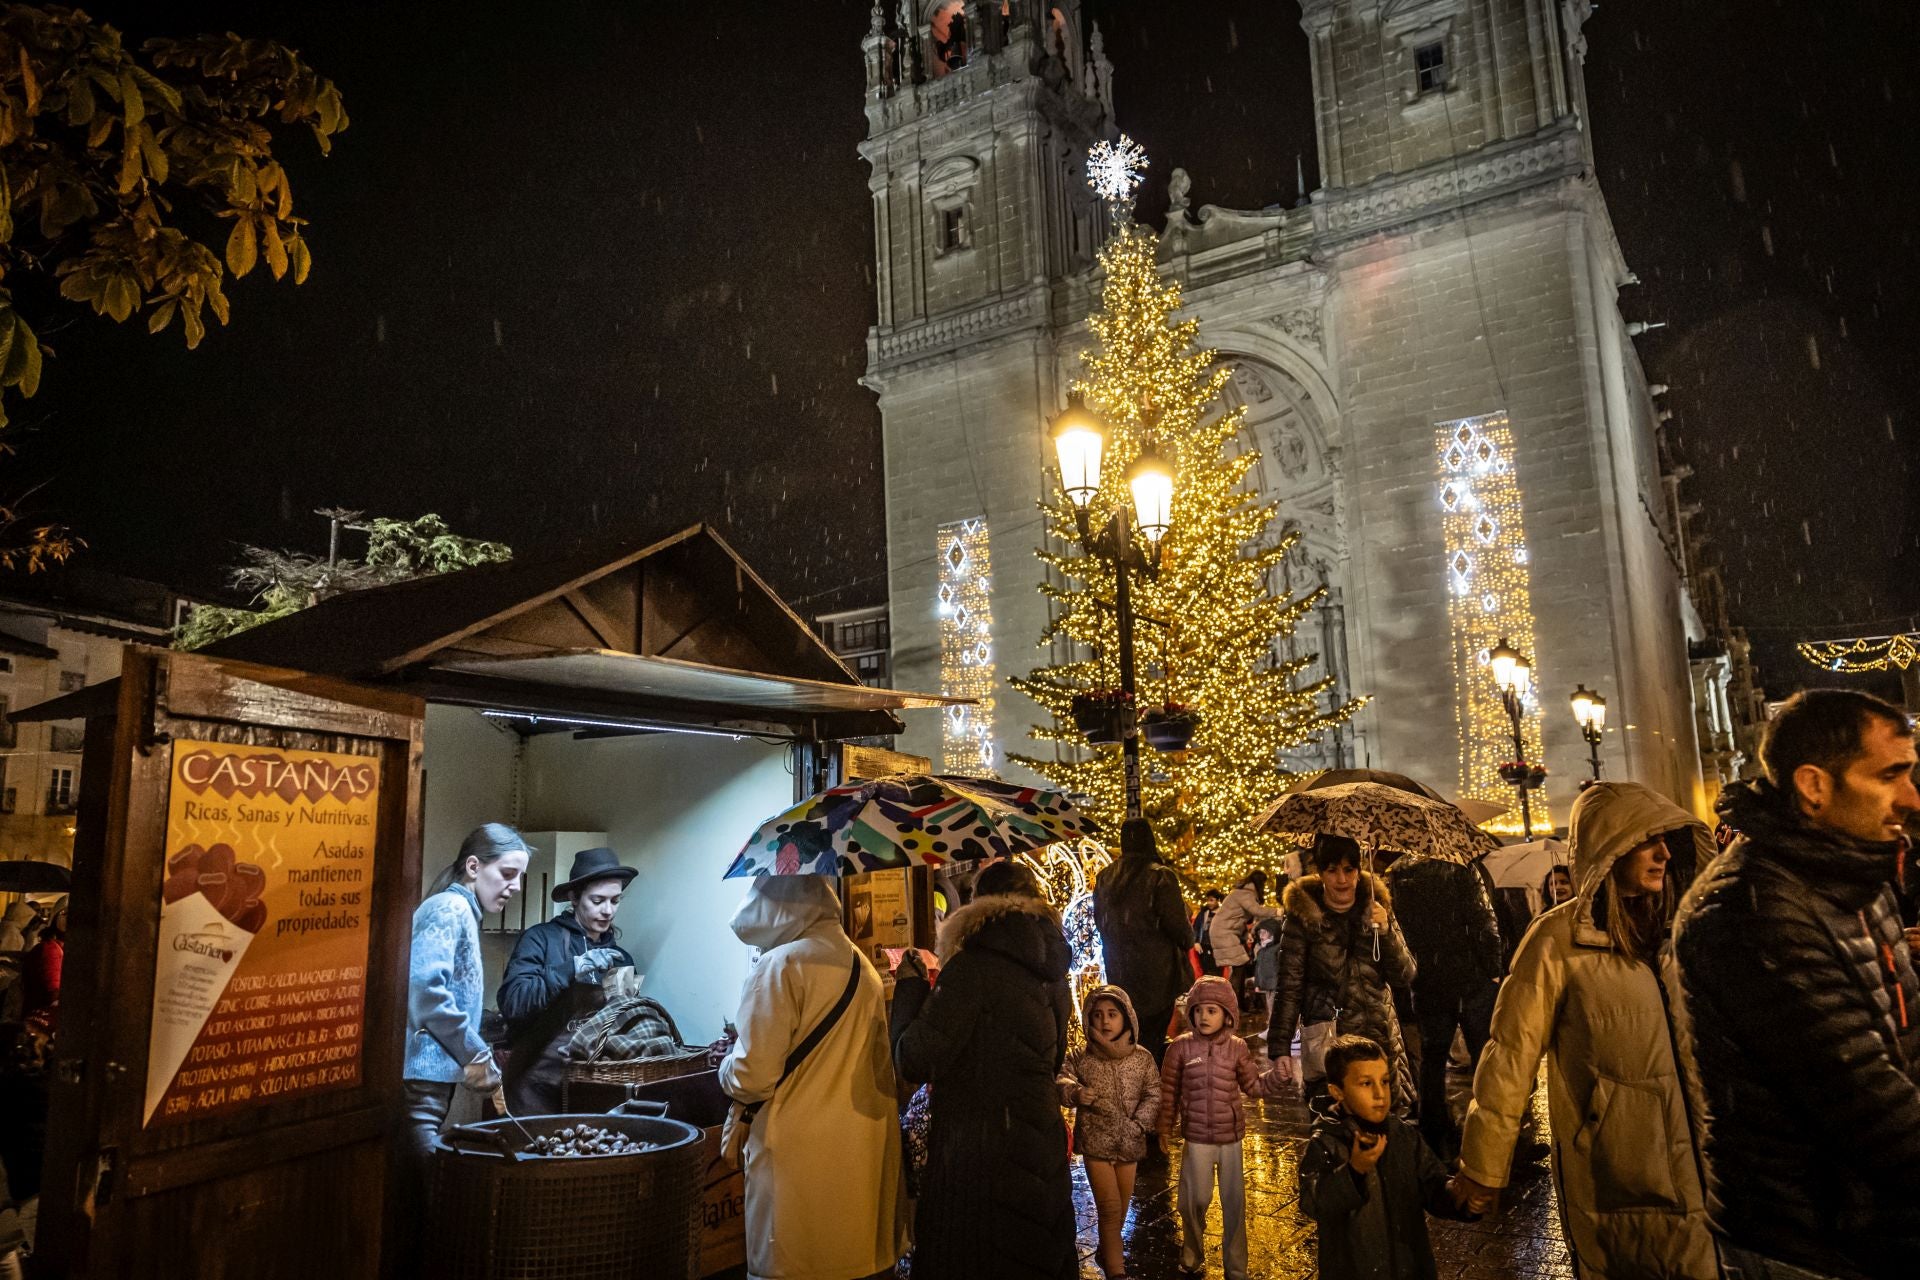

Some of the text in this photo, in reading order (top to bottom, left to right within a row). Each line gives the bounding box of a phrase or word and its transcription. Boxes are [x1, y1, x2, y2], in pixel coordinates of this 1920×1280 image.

[183, 754, 369, 794] CASTAÑAS
[184, 801, 371, 827] Ricas, Sanas y Nutritivas.
[313, 840, 364, 860] Asadas
[288, 867, 363, 883] mantienen
[299, 887, 361, 907] todas sus
[276, 910, 360, 937] propiedades
[218, 1000, 240, 1013] ZINC
[277, 989, 329, 1005] MANGANESO
[281, 1011, 312, 1024] TIAMINA
[191, 1043, 231, 1062] POTASIO
[237, 1034, 286, 1054] VITAMINAS
[265, 1052, 307, 1071] HIDRATOS
[307, 1051, 317, 1064] DE
[318, 1045, 357, 1062] CARBONO
[196, 1088, 225, 1108] AGUA
[285, 1075, 300, 1090] UN
[318, 1069, 329, 1084] DE
[329, 1065, 356, 1082] GRASA
